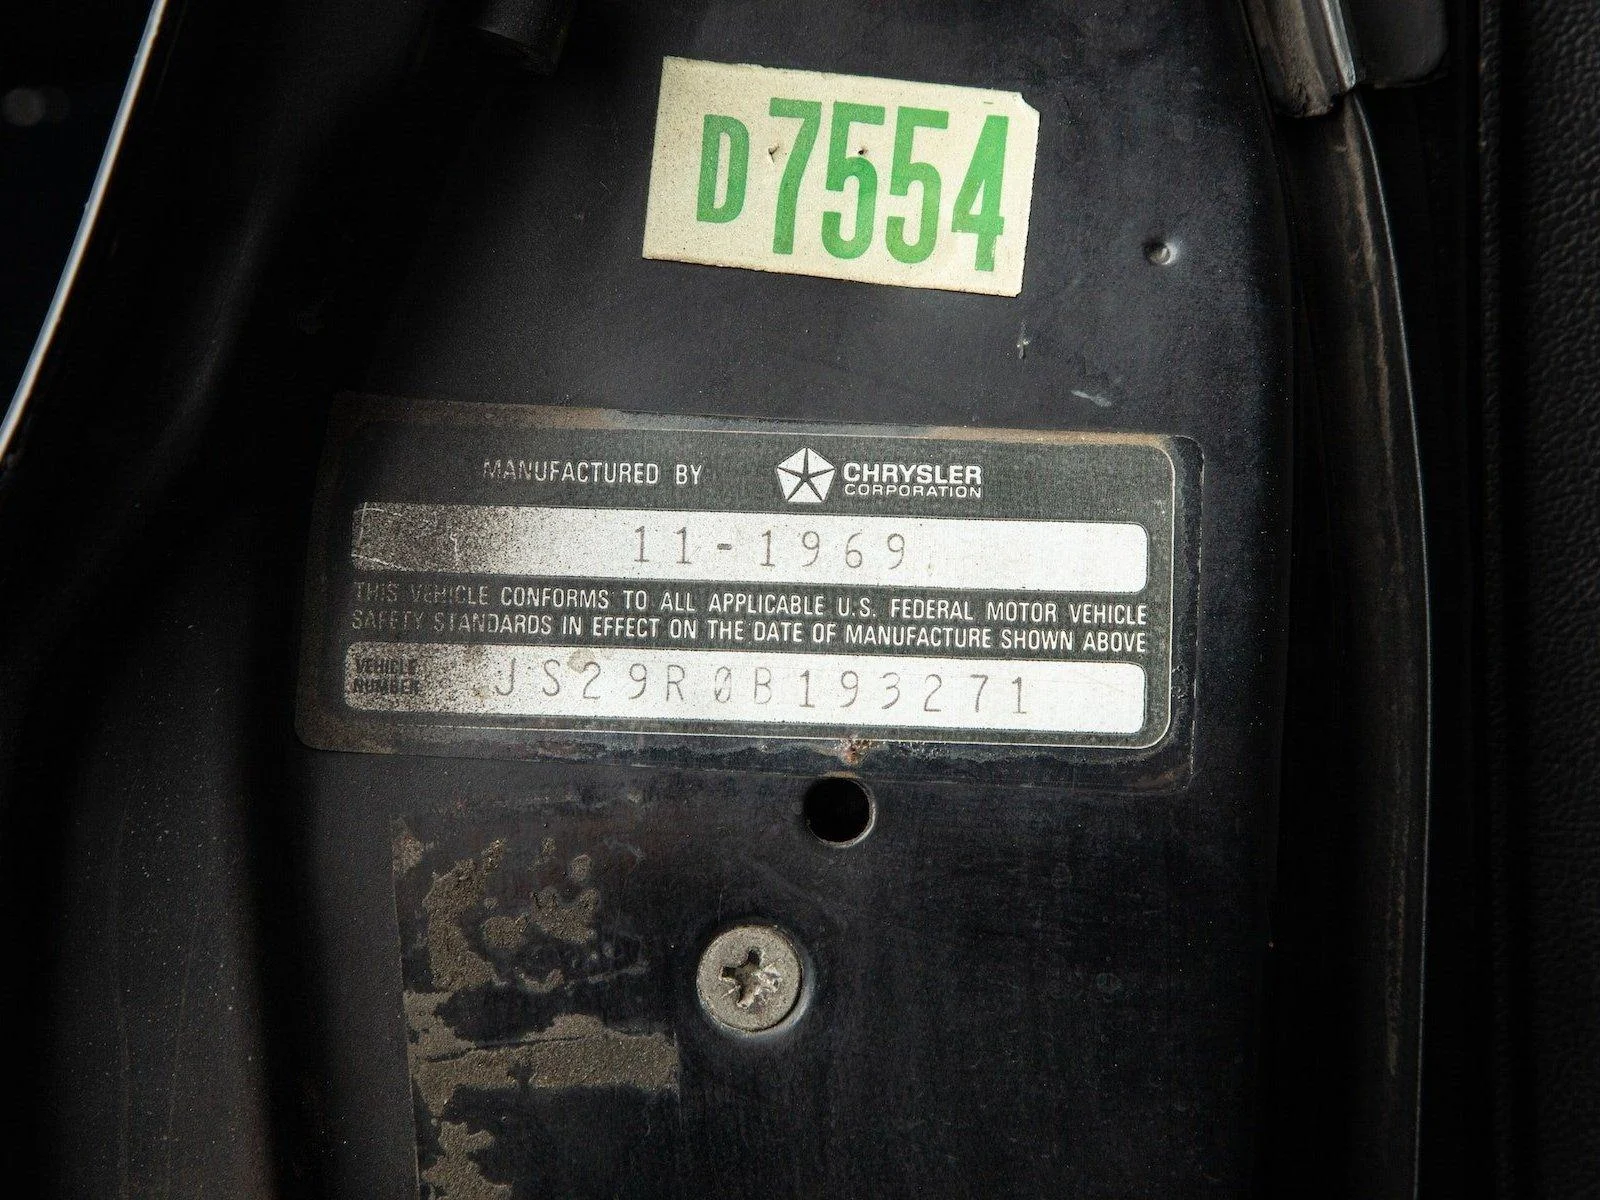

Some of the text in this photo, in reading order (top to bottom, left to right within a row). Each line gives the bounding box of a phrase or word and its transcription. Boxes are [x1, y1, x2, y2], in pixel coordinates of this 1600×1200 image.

[483, 459, 702, 484] MANUFACTURED BY
[843, 463, 982, 485] CHRYSLER
[844, 484, 982, 498] CORPORATION
[354, 581, 1147, 625] THIS VEHICLE CONFORMS TO ALL APPLICABLE U.S. FEDERAL MOTOR VEHICLE
[351, 609, 1146, 653] SAFETY STANDARDS IN EFFECT ON THE DATE OF MANUFACTURE SHOWN ABOVE
